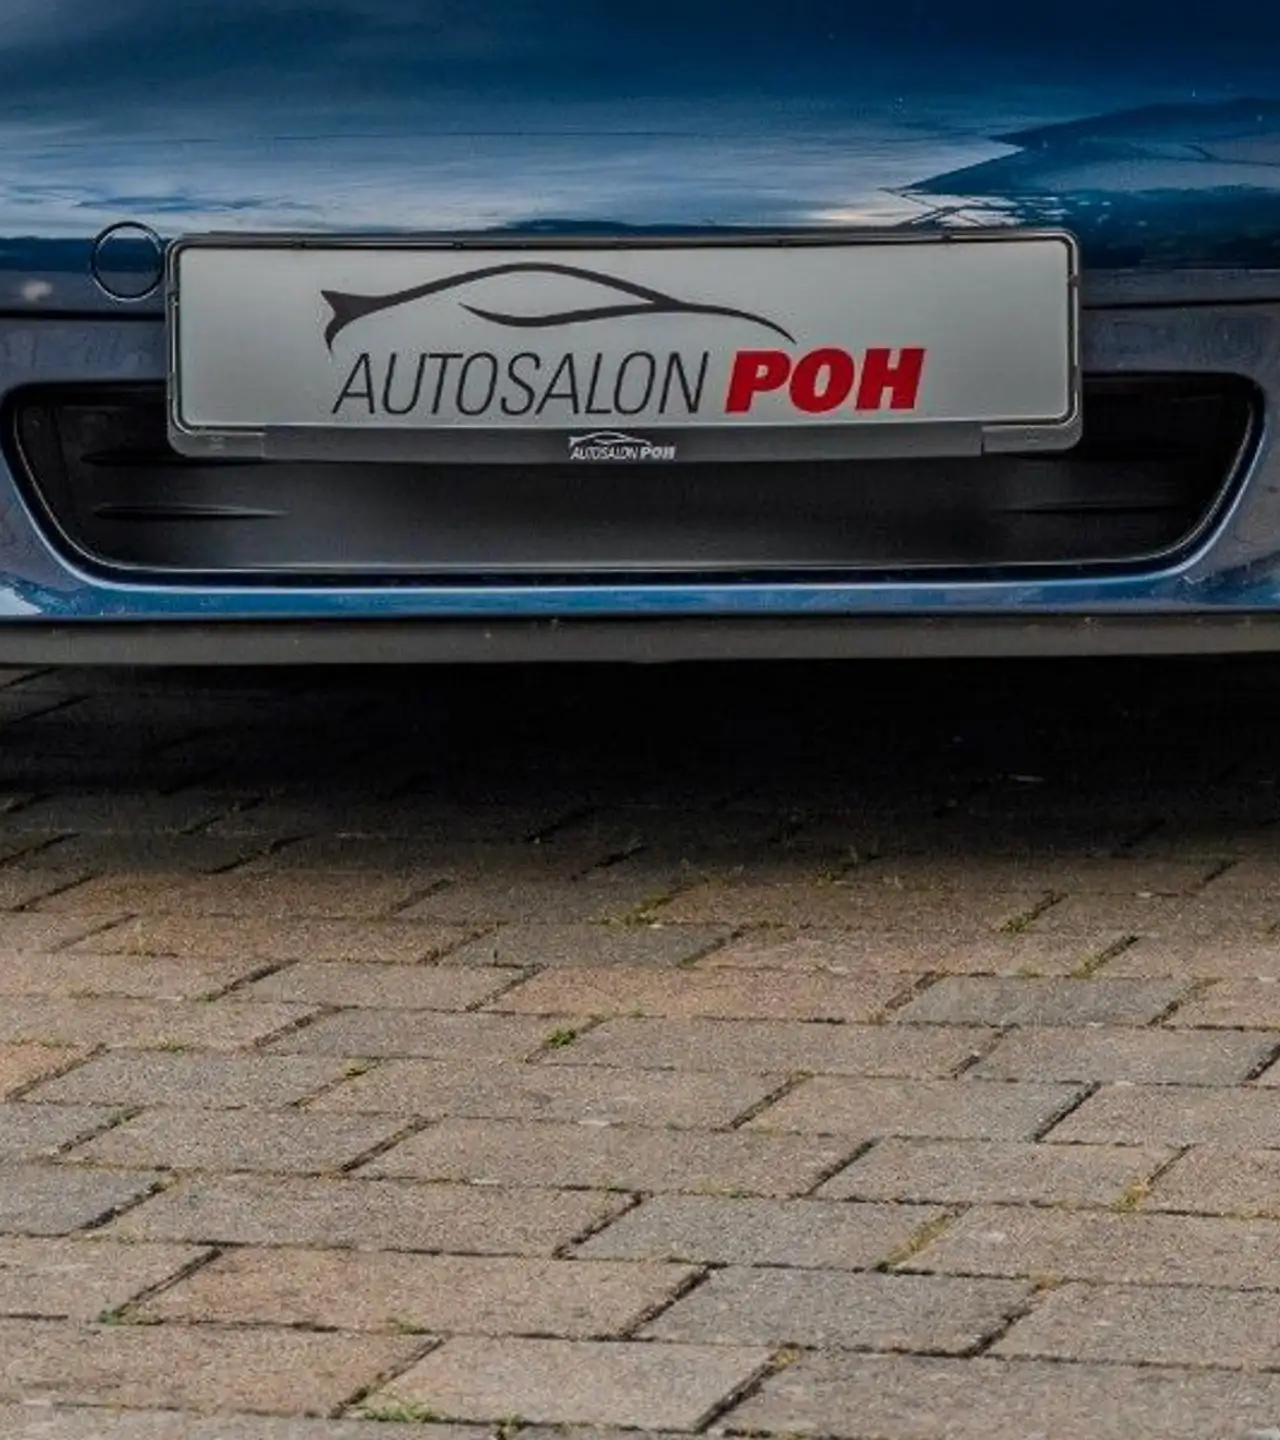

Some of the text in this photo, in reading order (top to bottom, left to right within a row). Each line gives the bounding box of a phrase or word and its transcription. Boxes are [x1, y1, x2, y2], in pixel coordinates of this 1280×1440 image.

[331, 346, 926, 416] AUTOSALON POH
[570, 446, 677, 460] AUTOSALON POH
